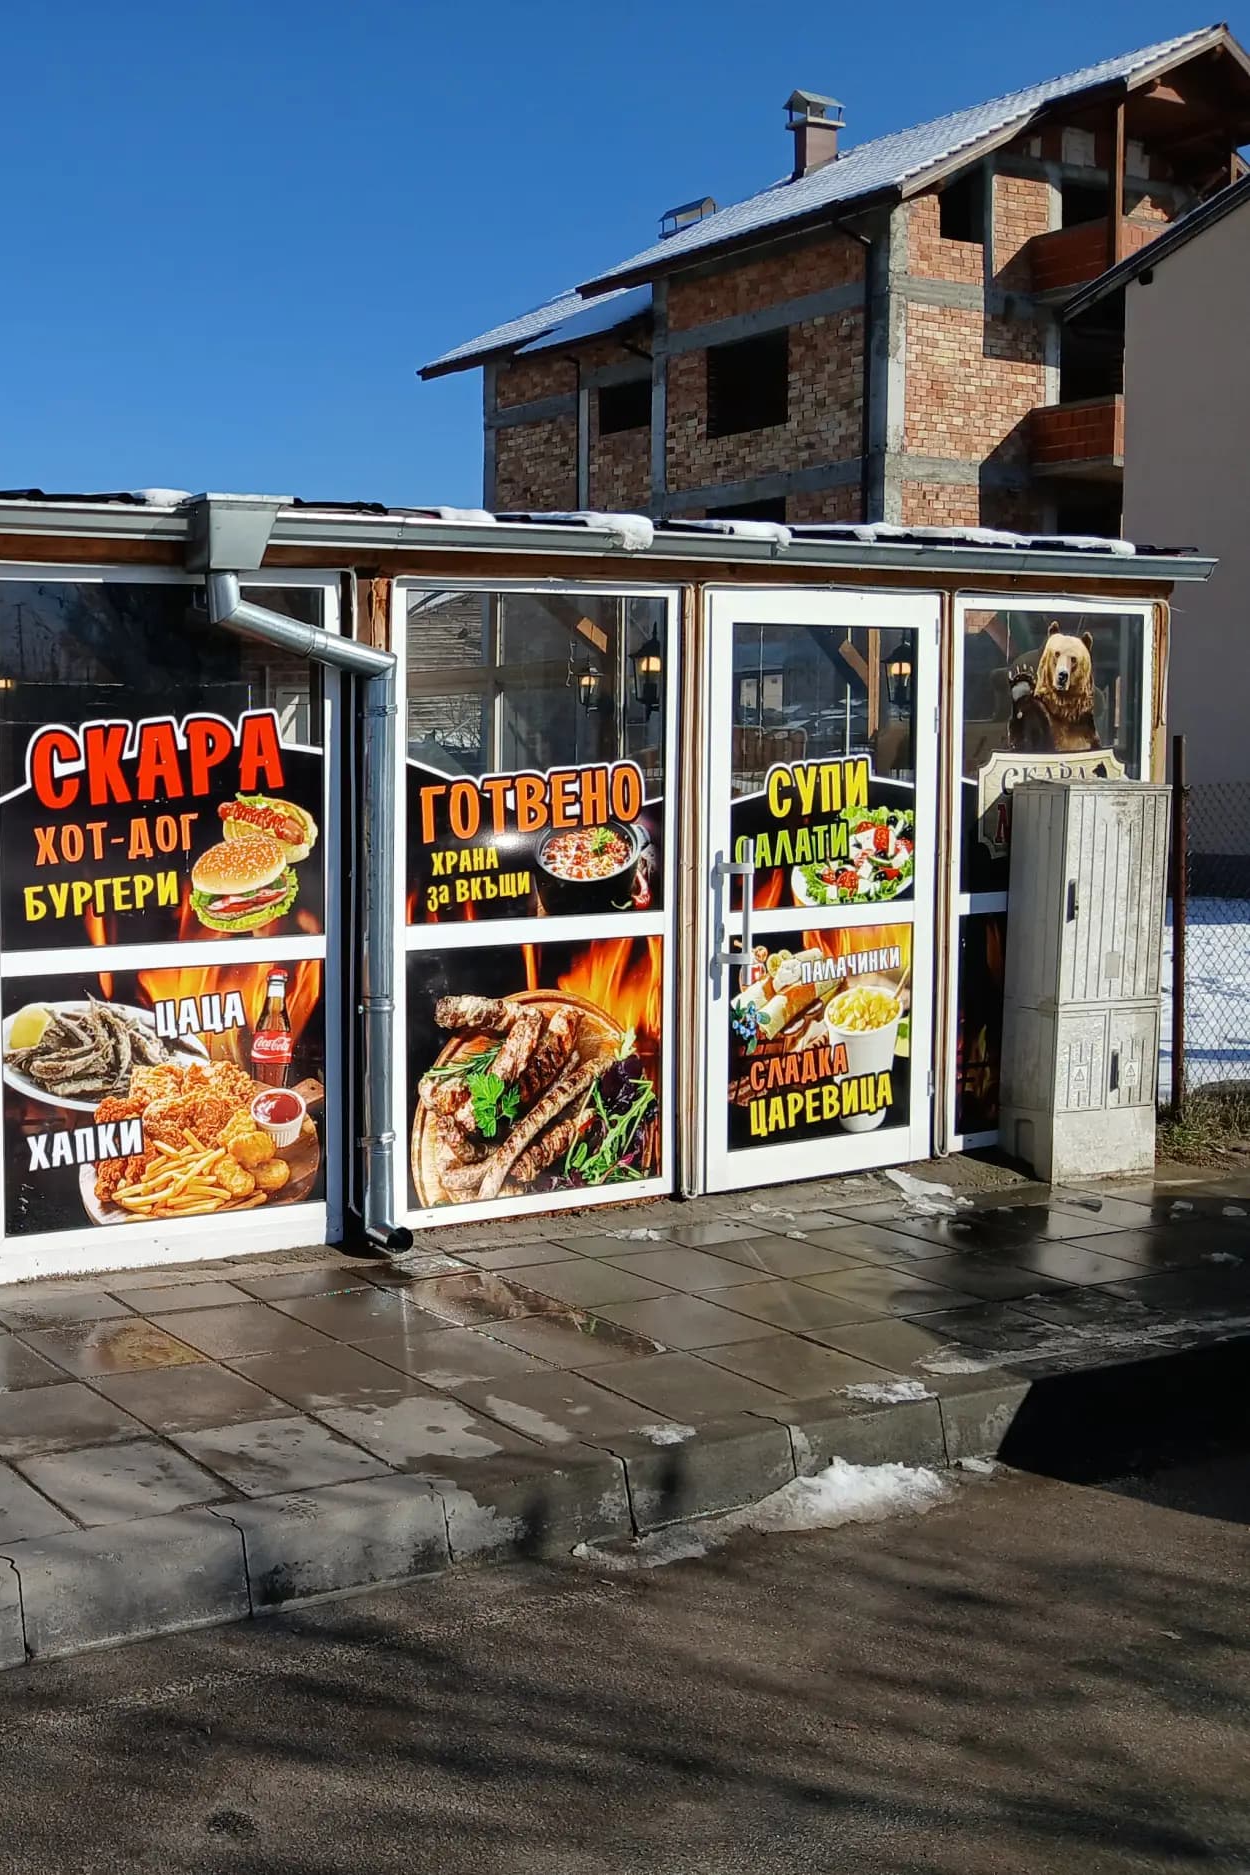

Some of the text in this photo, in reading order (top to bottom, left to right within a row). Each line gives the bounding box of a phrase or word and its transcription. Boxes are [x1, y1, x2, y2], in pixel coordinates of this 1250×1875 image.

[31, 714, 285, 809] СКАРА
[420, 767, 641, 844] ГОТВЕНО
[768, 760, 869, 818] СУПИ
[34, 812, 198, 866] ХОТ-ДОГ
[431, 847, 499, 877] ХРАНА
[23, 871, 179, 921] БУРГЕРИ
[456, 871, 531, 902] ВКЪЩИ
[801, 946, 901, 985] ПАЛАЧИНКИ
[155, 991, 247, 1040] ЦАЦА
[750, 1043, 848, 1092] СЛАДКА
[750, 1072, 893, 1137] ЦАРЕВИЦА
[27, 1119, 144, 1172] ХАПКИ
